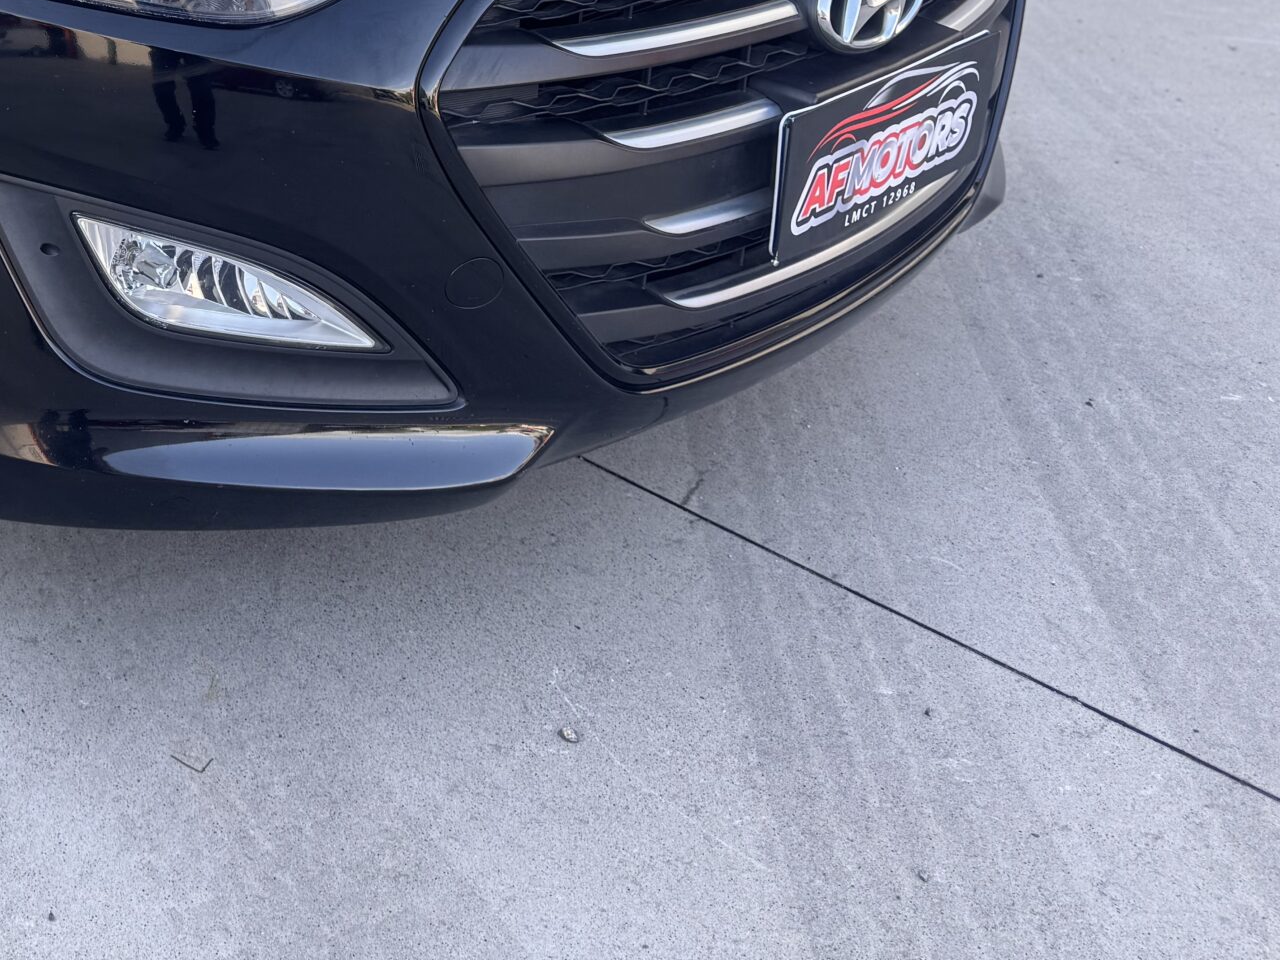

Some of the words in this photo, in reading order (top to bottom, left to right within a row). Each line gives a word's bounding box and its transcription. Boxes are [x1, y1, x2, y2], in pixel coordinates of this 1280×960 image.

[799, 99, 972, 222] AFMOTORS
[844, 200, 877, 227] LMCT
[882, 181, 916, 208] 12968
